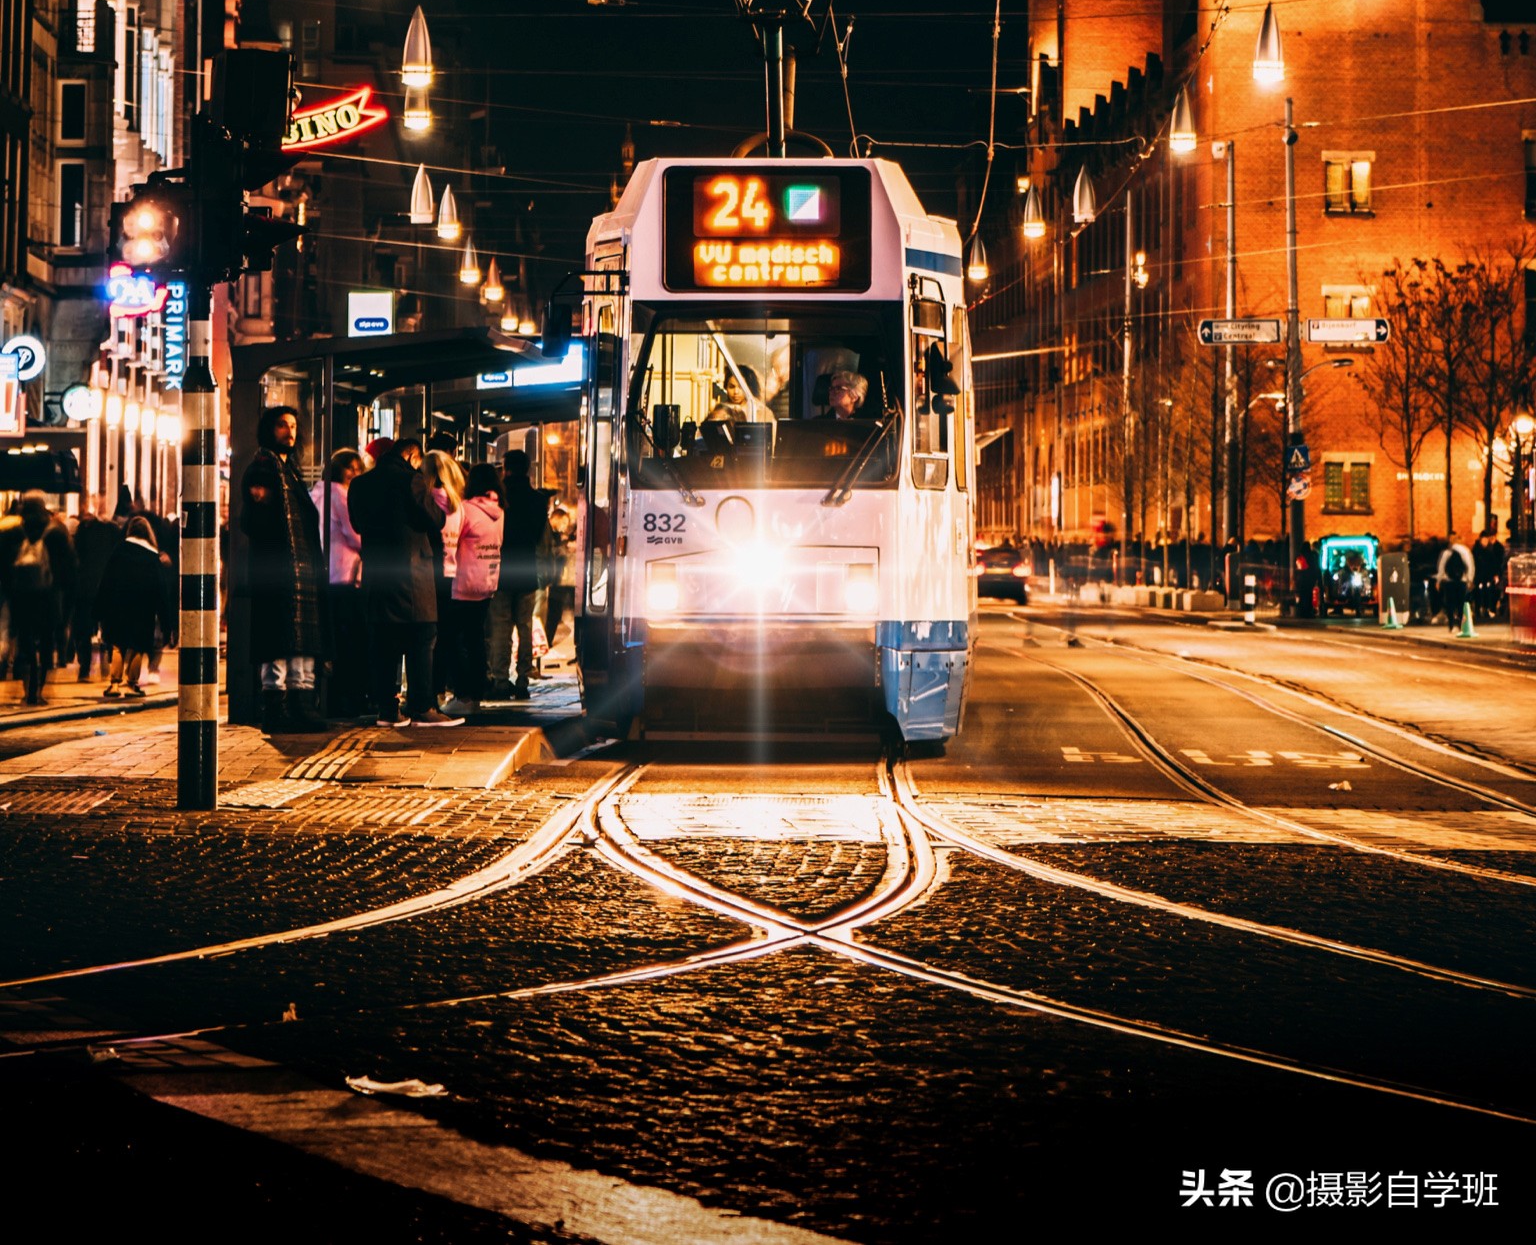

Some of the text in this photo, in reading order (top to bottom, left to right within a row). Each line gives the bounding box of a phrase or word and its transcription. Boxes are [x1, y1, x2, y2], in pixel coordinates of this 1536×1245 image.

[713, 182, 769, 226] 24
[700, 243, 833, 265] VU medisch
[712, 264, 820, 282] centrum
[165, 284, 184, 391] PRIMARK
[643, 513, 686, 532] 832
